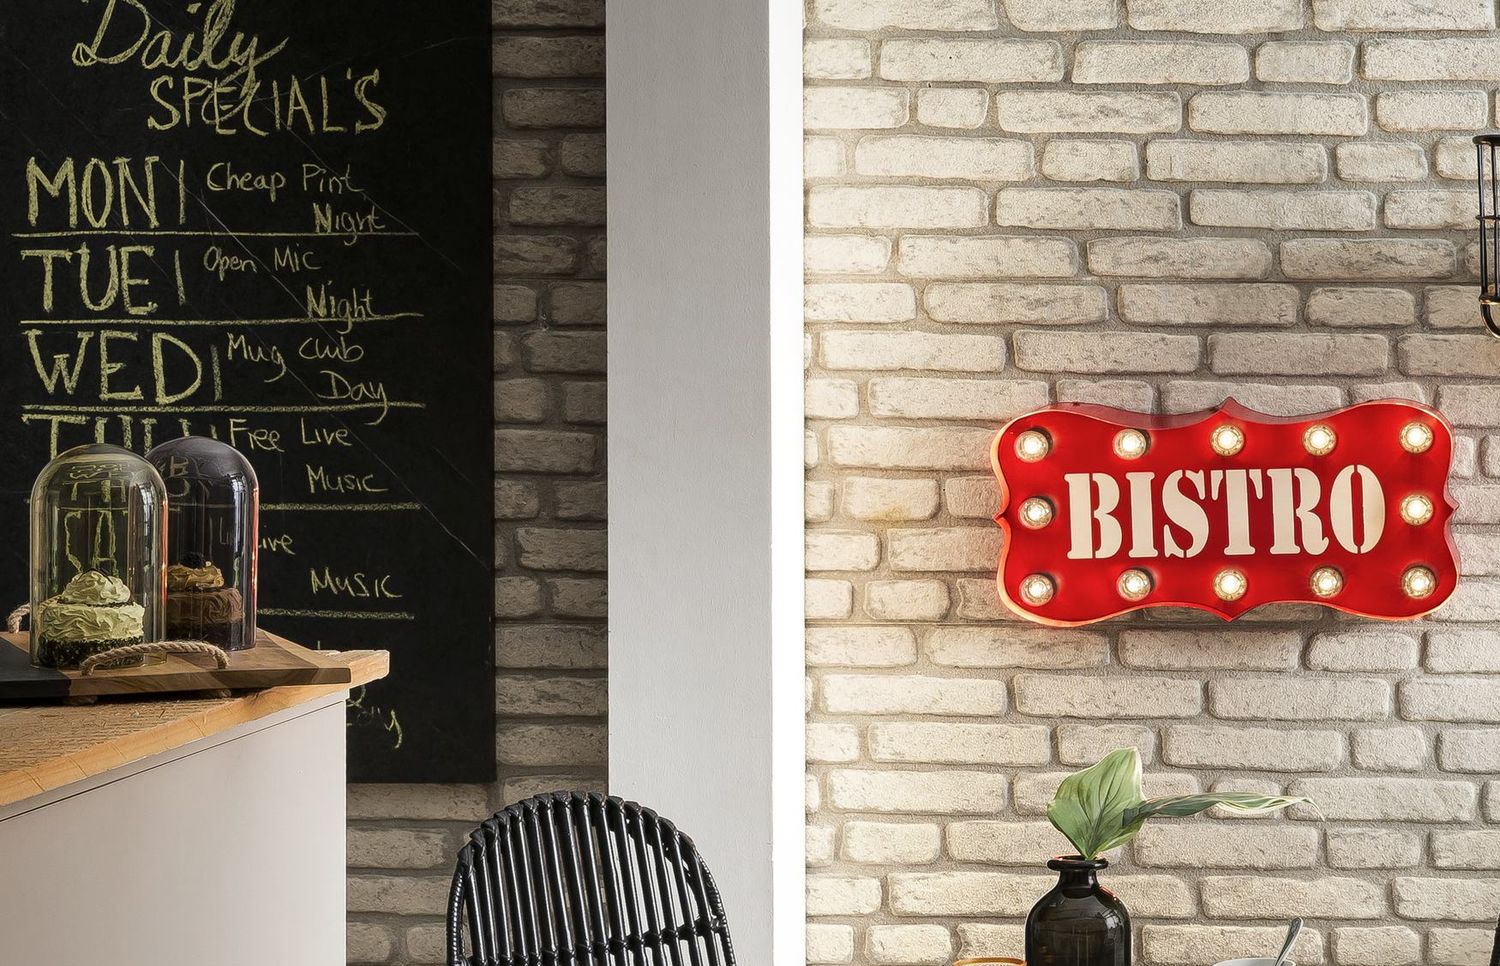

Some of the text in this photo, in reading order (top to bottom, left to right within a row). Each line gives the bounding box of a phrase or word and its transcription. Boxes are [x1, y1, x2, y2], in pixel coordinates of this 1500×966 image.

[72, 0, 289, 122] Daily
[25, 156, 160, 229] MON
[206, 162, 366, 202] Cheap Pint
[313, 203, 386, 246] Night
[20, 243, 158, 315] TUE
[203, 246, 257, 281] Open
[306, 280, 380, 334] Night
[22, 329, 202, 404] WED
[227, 332, 286, 382] Mug
[316, 370, 388, 425] Day
[229, 418, 285, 453] Free
[300, 417, 353, 446] Live
[1064, 464, 1386, 560] BISTRO
